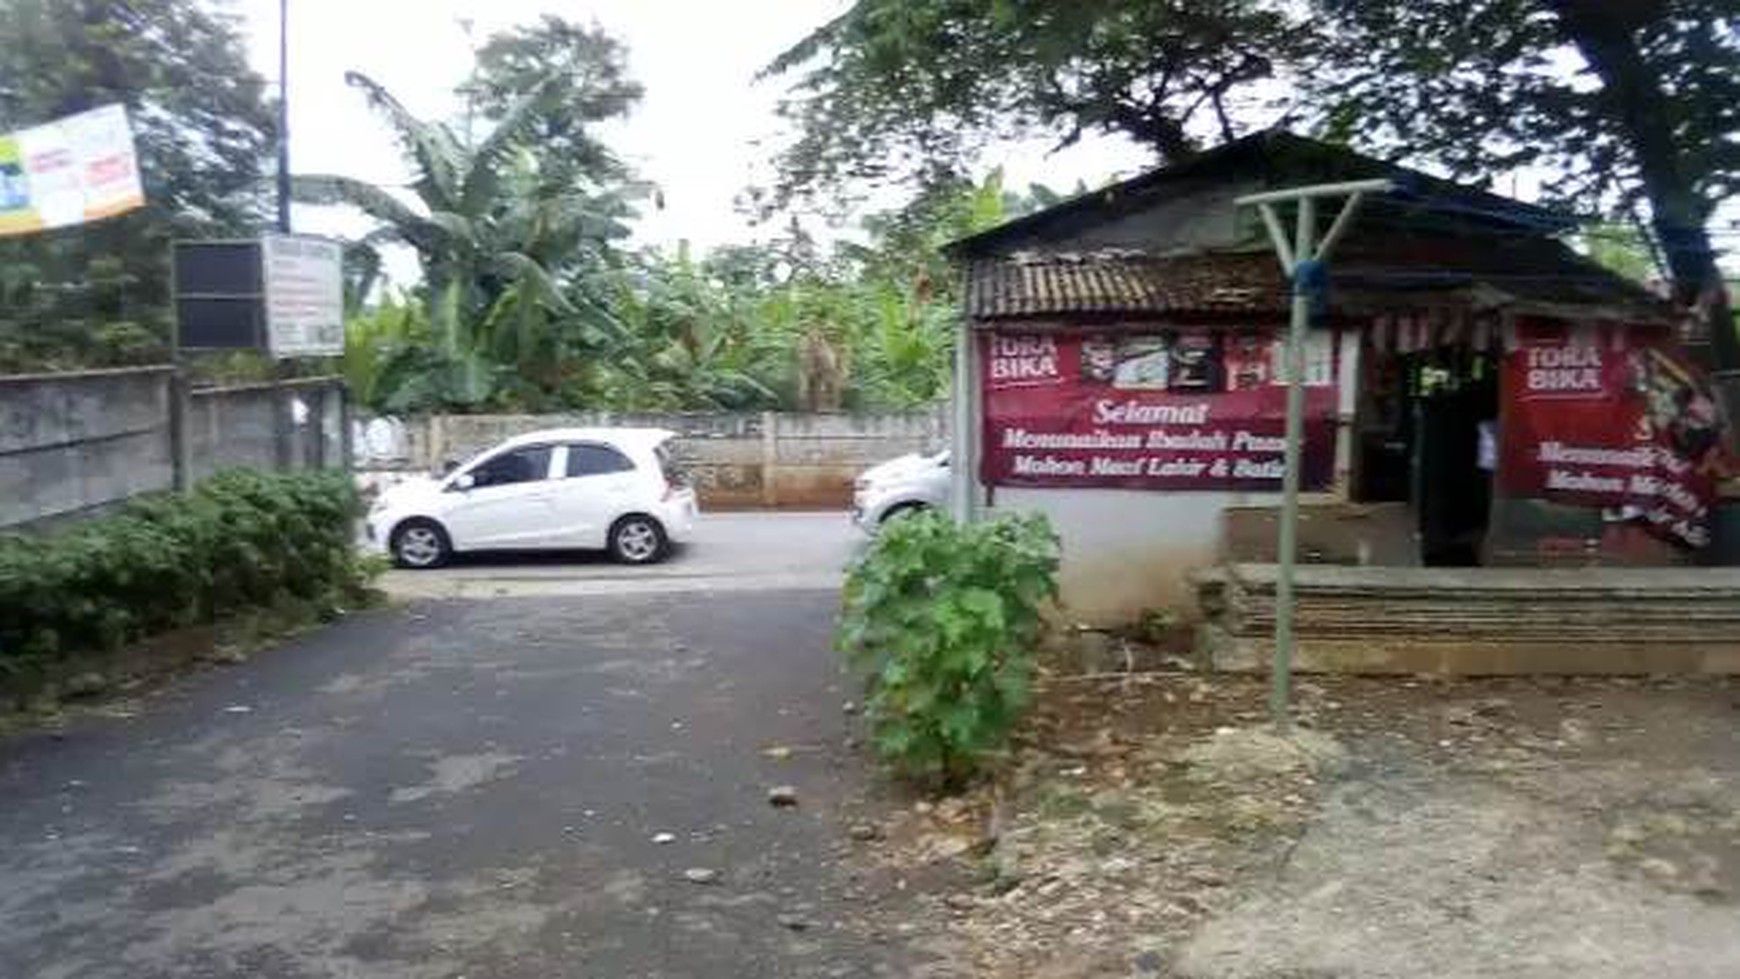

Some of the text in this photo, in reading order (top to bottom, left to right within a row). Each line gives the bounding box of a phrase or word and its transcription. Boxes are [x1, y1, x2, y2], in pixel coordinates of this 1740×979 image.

[992, 356, 1058, 377] BIKA
[1528, 347, 1601, 367] TORA
[1528, 368, 1602, 388] BIKA
[1093, 400, 1210, 424] Selamat
[1003, 428, 1141, 448] Menunaikan
[1014, 455, 1085, 475] Mohon
[1090, 457, 1145, 475] Maaf
[1148, 457, 1208, 476] Lahir
[1210, 457, 1229, 477] &
